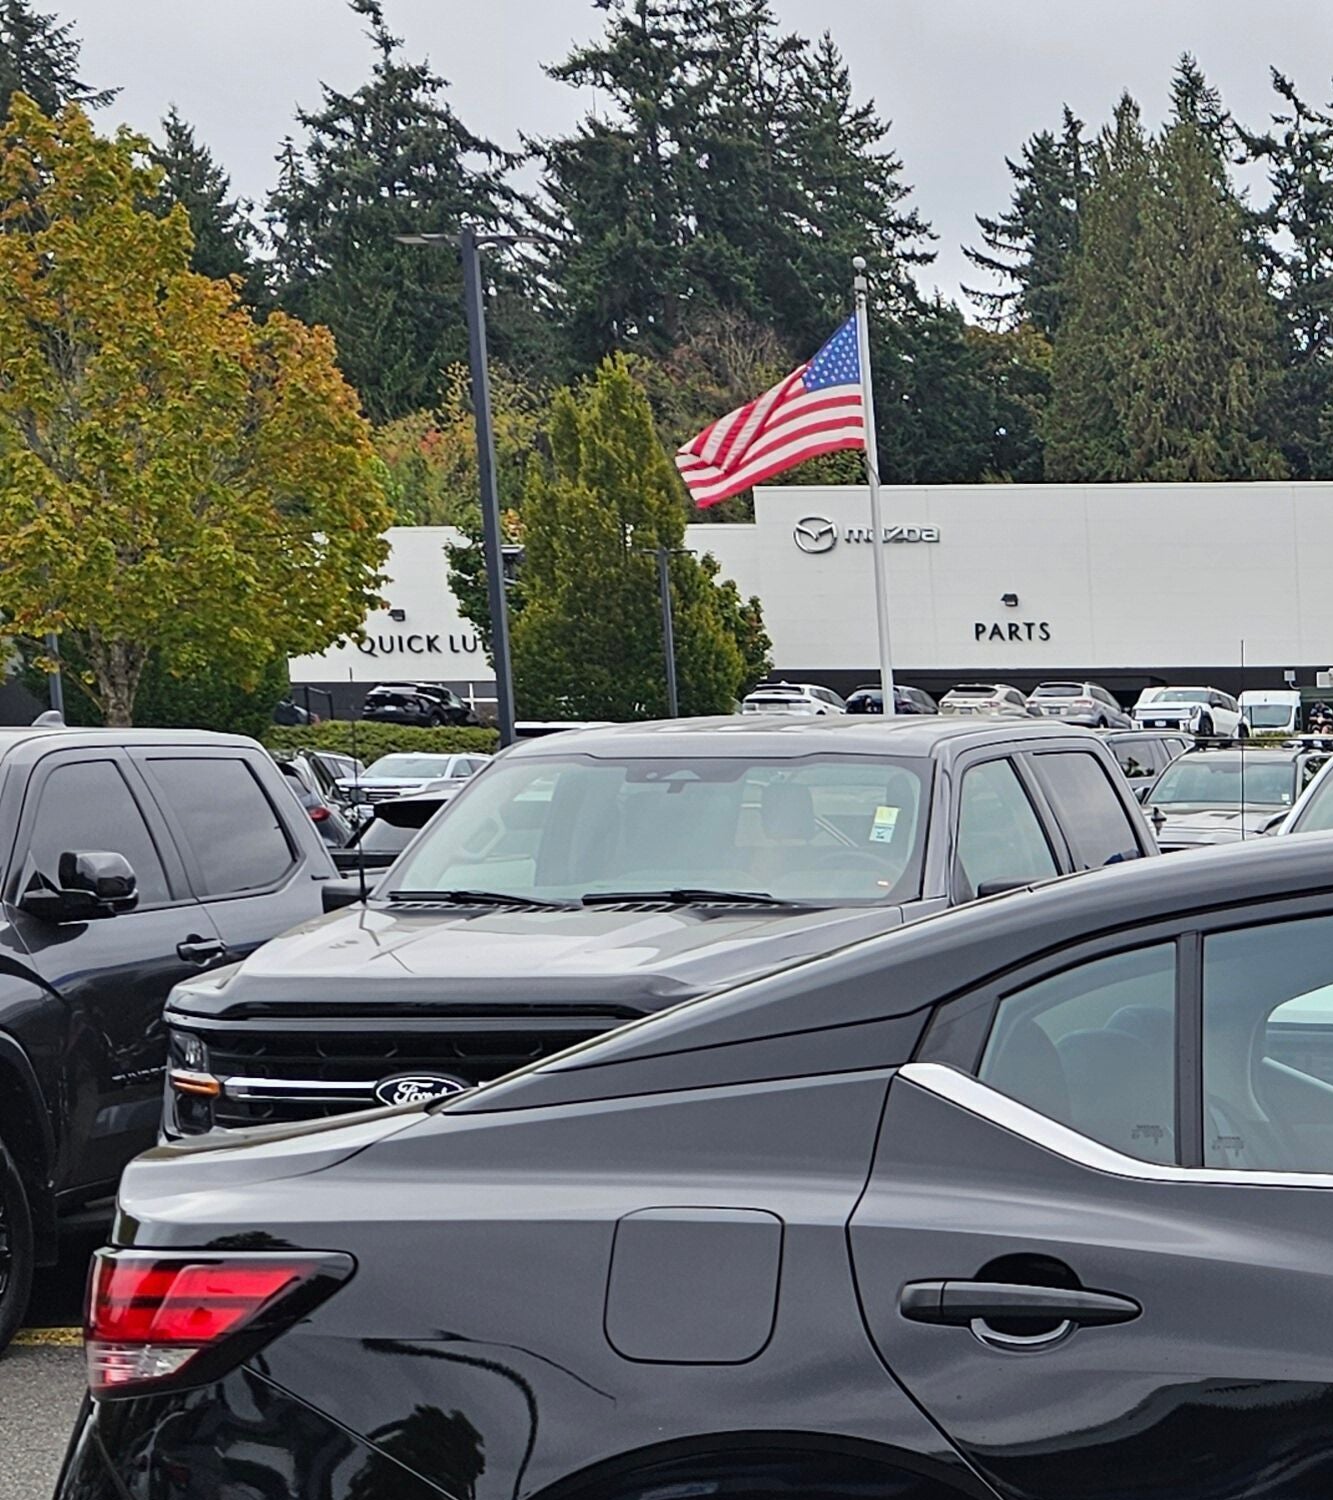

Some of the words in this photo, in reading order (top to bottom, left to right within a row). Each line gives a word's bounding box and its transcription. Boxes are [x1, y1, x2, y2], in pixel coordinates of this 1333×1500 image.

[844, 525, 940, 544] mzda
[974, 621, 1051, 642] PARTS
[358, 634, 443, 658] QUICK
[449, 634, 492, 654] LU
